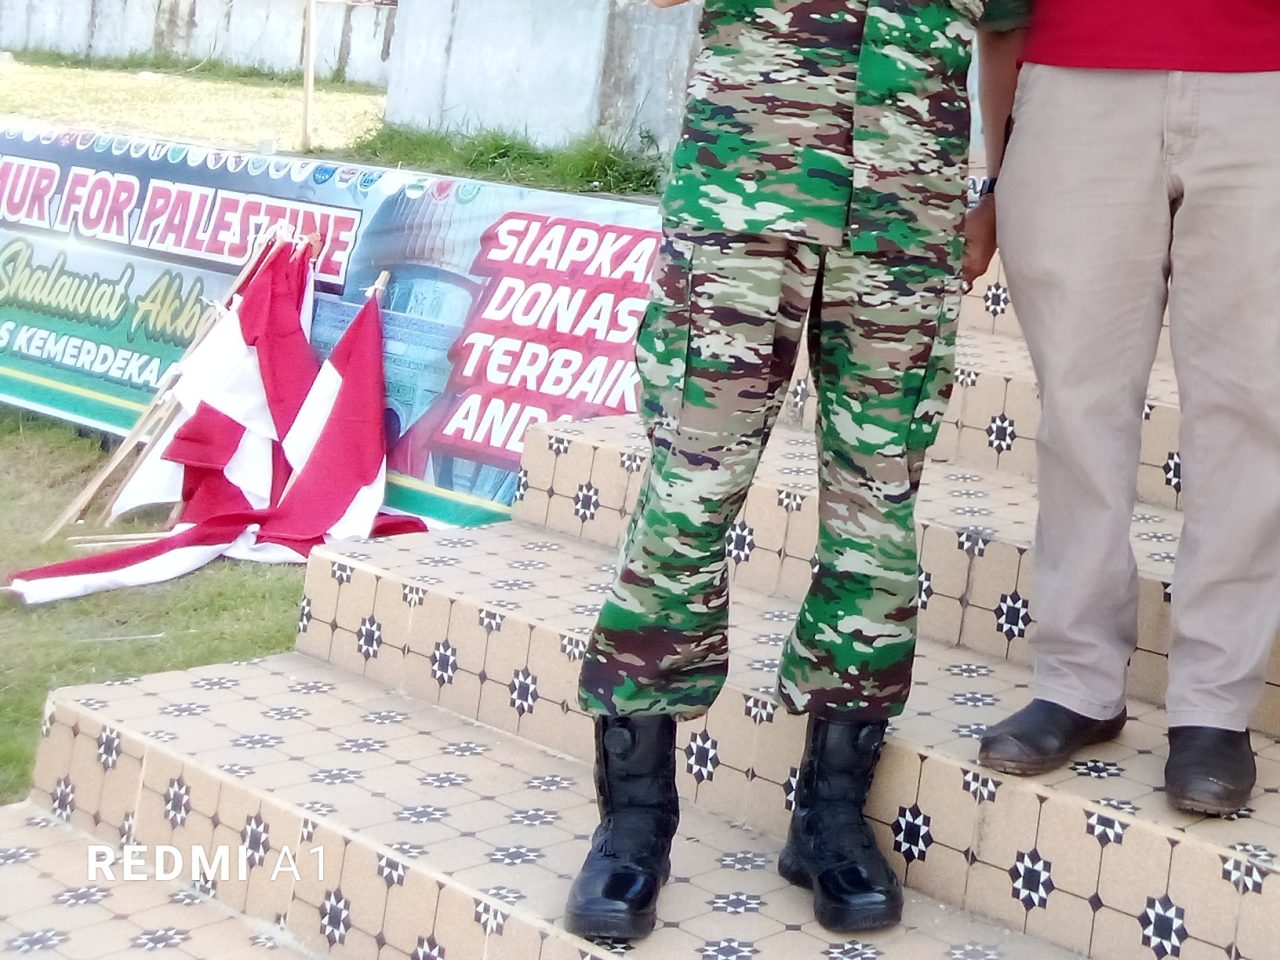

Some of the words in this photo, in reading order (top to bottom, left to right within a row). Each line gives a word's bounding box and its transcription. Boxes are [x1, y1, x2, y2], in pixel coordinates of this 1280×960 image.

[60, 171, 137, 239] FOR
[487, 217, 658, 285] SIAPKA
[481, 276, 651, 345] DONAS
[463, 331, 641, 413] TERBAIK
[442, 392, 573, 454] AND
